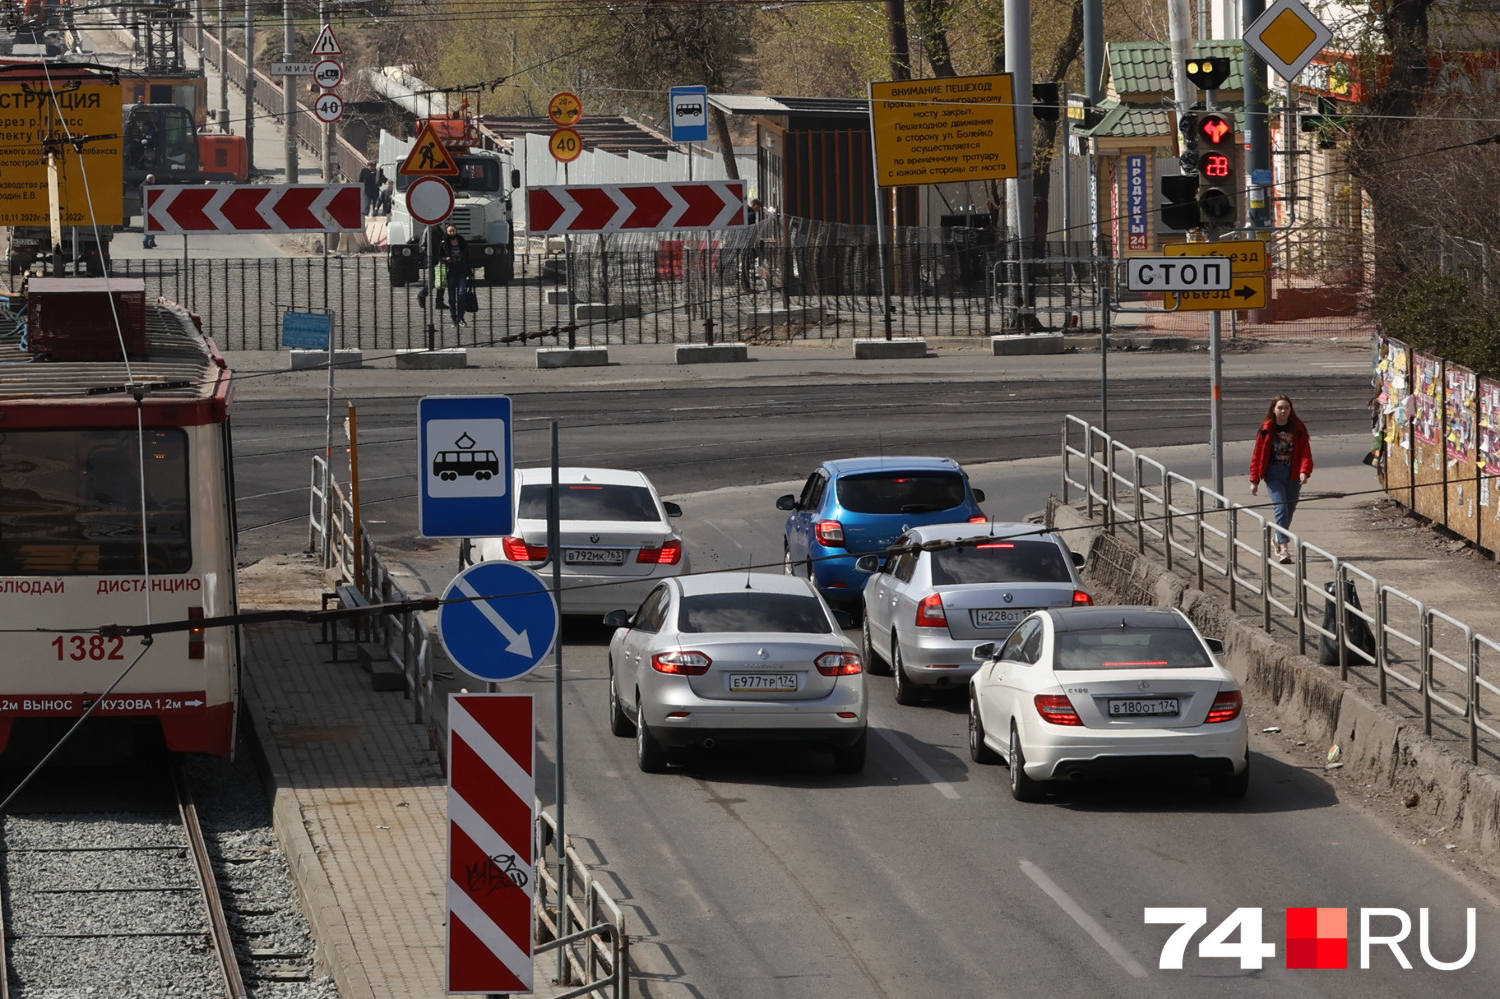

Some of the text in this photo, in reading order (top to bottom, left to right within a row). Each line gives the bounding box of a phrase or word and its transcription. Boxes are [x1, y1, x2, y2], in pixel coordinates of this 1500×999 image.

[285, 65, 315, 73] МИАС
[892, 83, 992, 96] ВНИМАНИЕ ПЕШЕХОД!
[320, 101, 338, 114] 40
[884, 100, 915, 110] Проход
[913, 110, 938, 119] мосту
[895, 118, 994, 131] Пешеходное движение
[905, 133, 939, 143] сторону
[956, 129, 993, 139] Болейко
[556, 138, 576, 152] 40
[911, 142, 981, 154] осуществляется
[907, 155, 959, 165] временному
[962, 153, 999, 162] тротуару
[896, 166, 927, 176] южной
[929, 166, 966, 176] стороны
[981, 163, 1007, 171] моста
[1206, 156, 1228, 177] 28
[40, 182, 63, 190] рат:
[1131, 158, 1145, 234] ПРОДУКТЫ
[1130, 235, 1146, 245] 24
[1138, 264, 1221, 285] СТОП
[568, 550, 621, 561] В792МК 763
[97, 578, 201, 595] ДИСТАНЦИЮ
[981, 610, 1020, 621] Н228ОТ
[51, 634, 124, 661] 1382
[733, 675, 795, 687] Е977ТР 174
[23, 700, 73, 710] ВЫНОС
[101, 699, 151, 710] КУЗОВА
[155, 699, 182, 711] 1,2м
[1113, 700, 1176, 713] В180ОТ 174
